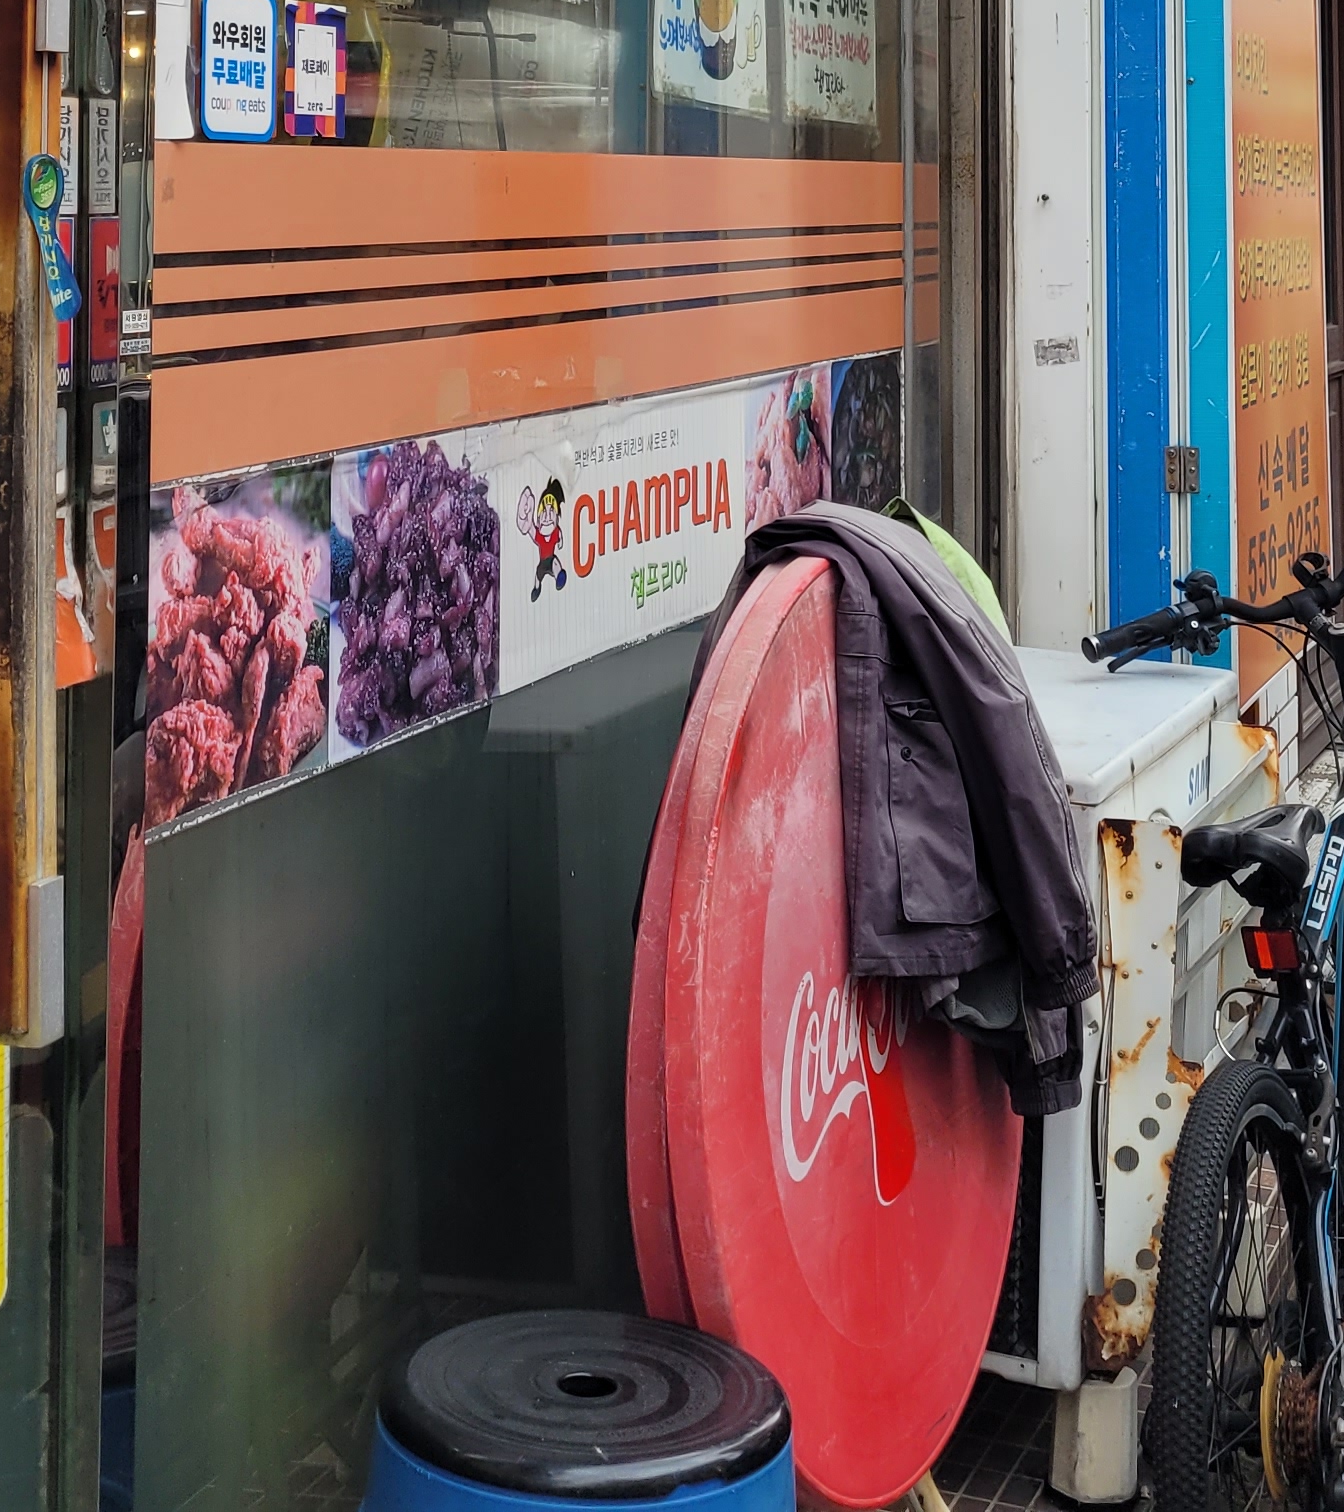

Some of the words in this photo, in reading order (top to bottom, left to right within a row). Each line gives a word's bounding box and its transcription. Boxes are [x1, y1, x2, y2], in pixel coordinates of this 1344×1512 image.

[211, 19, 267, 55] 와우회원
[210, 57, 267, 90] 무료배달
[301, 57, 331, 77] 제로페이
[646, 430, 670, 455] 새로운
[1258, 420, 1310, 511] 신속배달
[629, 556, 689, 611] 챔프리아
